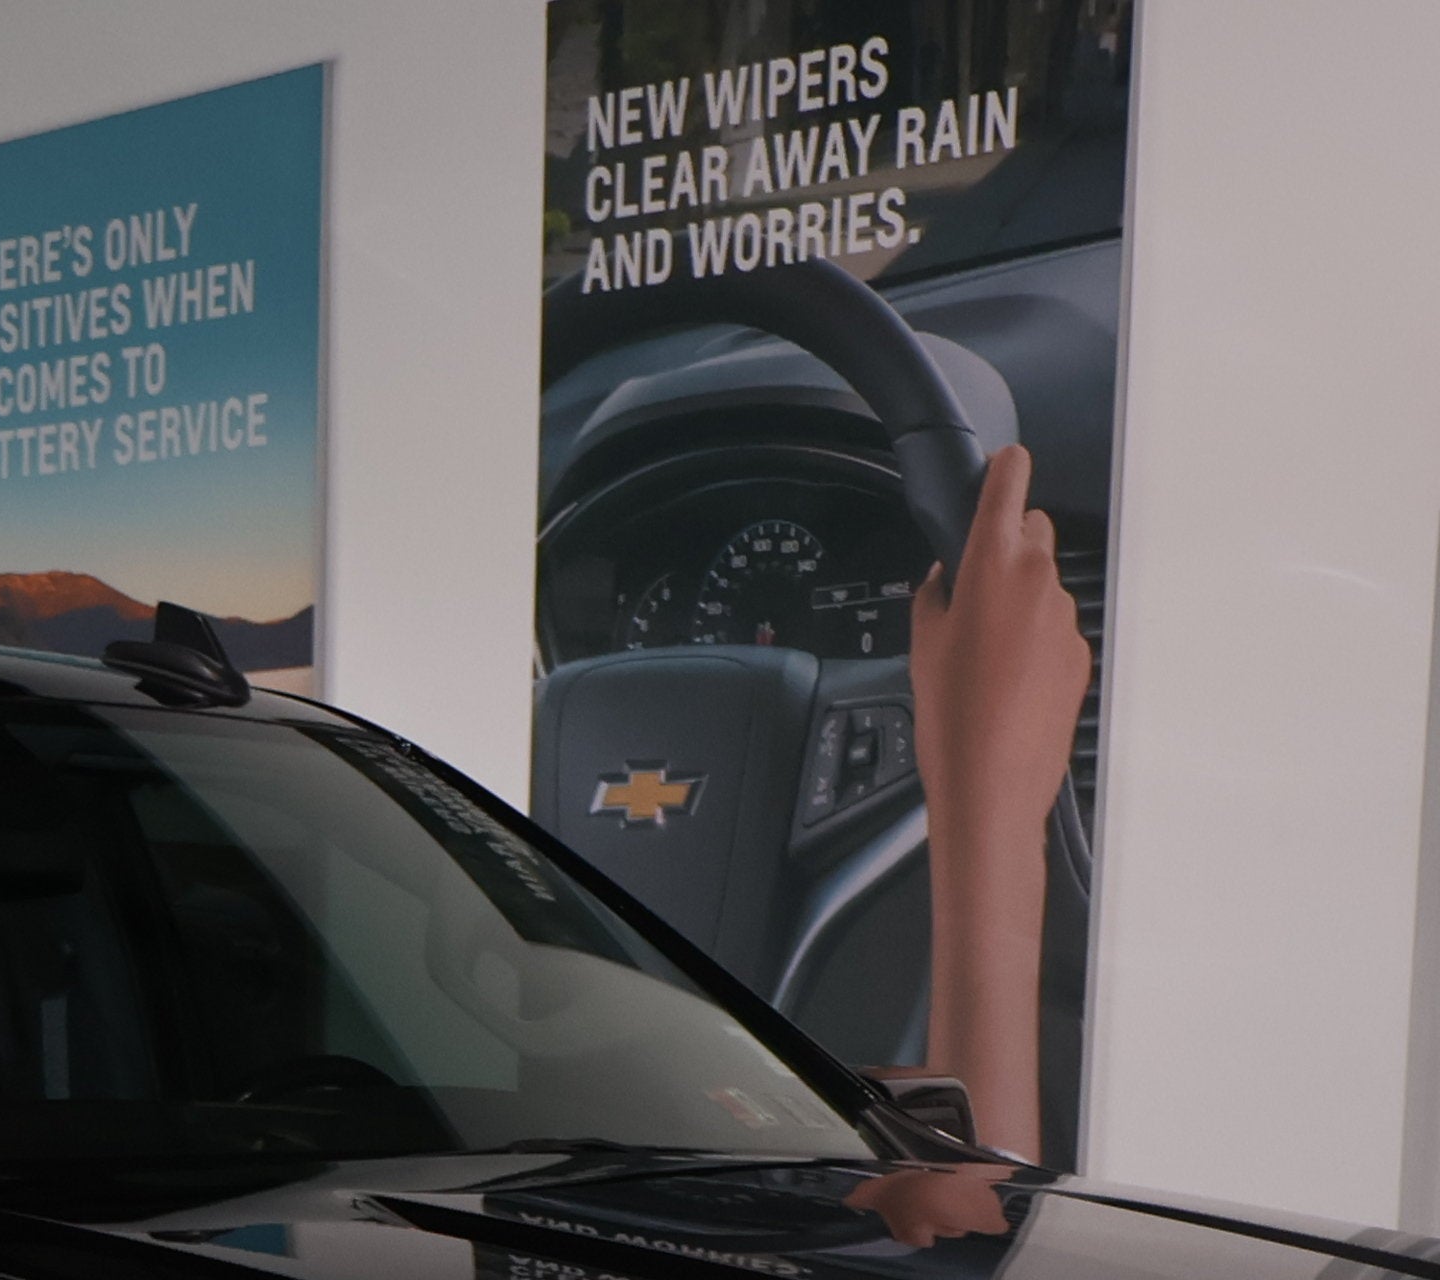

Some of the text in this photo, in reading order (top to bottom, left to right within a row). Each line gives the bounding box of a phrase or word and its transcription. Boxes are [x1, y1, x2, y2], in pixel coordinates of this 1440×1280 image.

[587, 36, 890, 152] NEW WIPERS
[585, 86, 1018, 223] CLEAR AWAY RAIN
[104, 202, 199, 272] ONLY
[582, 187, 921, 295] AND WORRIES.
[142, 260, 256, 330] WHEN
[122, 343, 167, 398] TO
[113, 393, 269, 467] SERVICE
